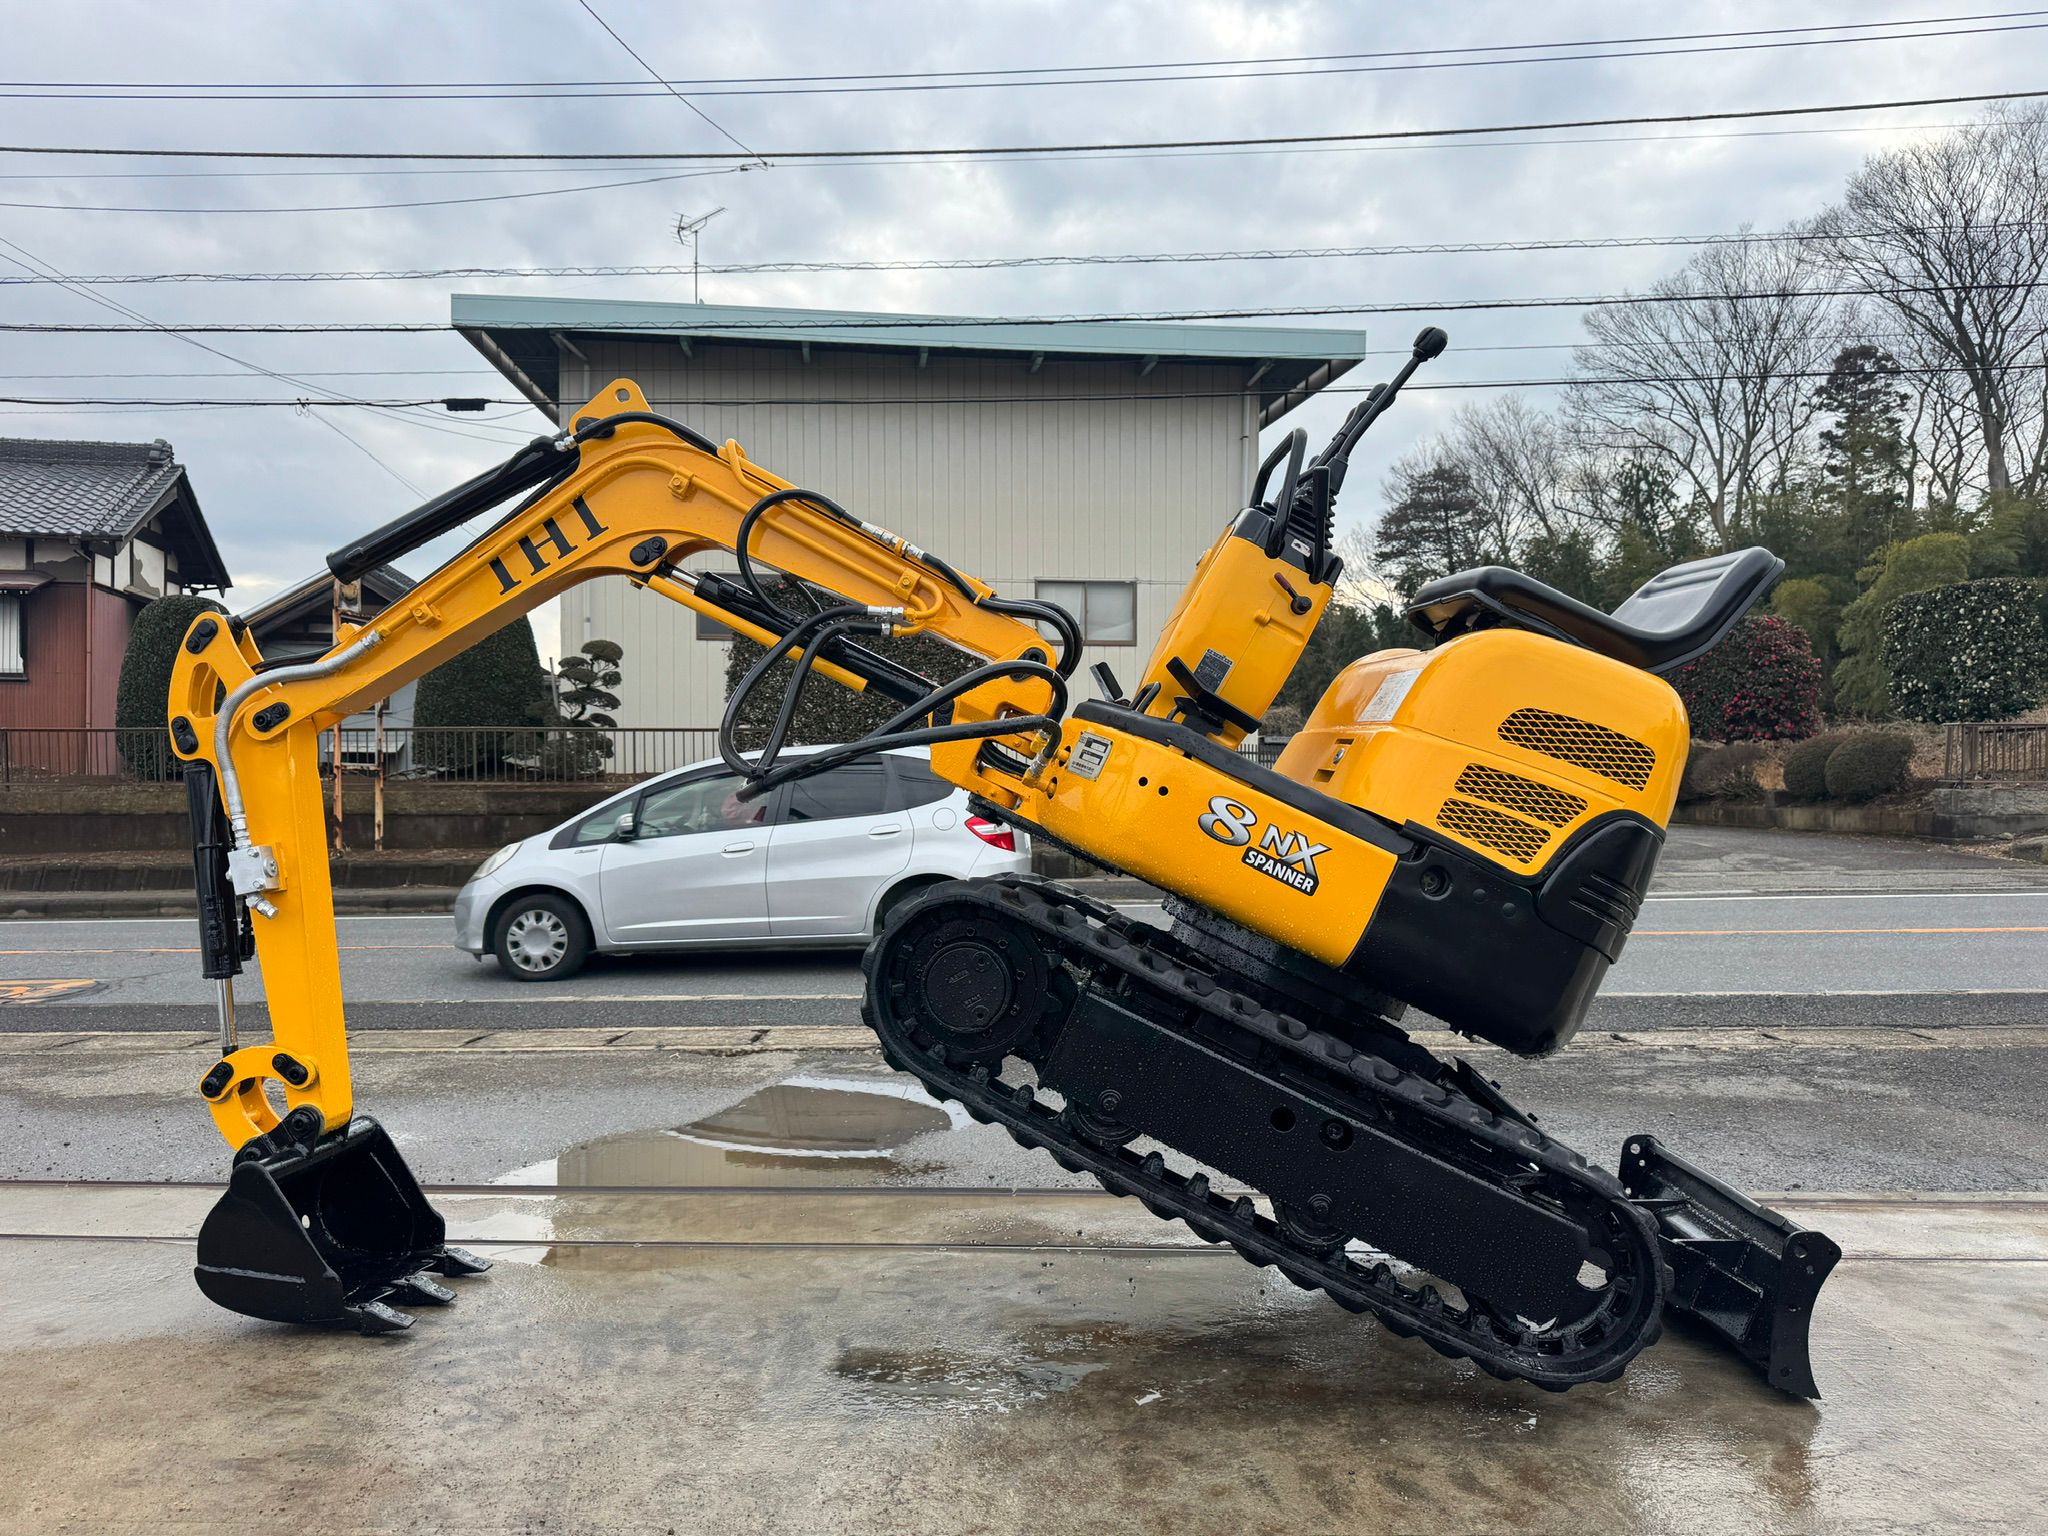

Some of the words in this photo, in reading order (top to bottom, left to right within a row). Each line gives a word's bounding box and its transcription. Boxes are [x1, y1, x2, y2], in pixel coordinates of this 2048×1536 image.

[488, 494, 609, 595] IHI
[1198, 796, 1257, 847] 8
[1259, 823, 1333, 877] NX
[1245, 850, 1315, 893] SPANNER
